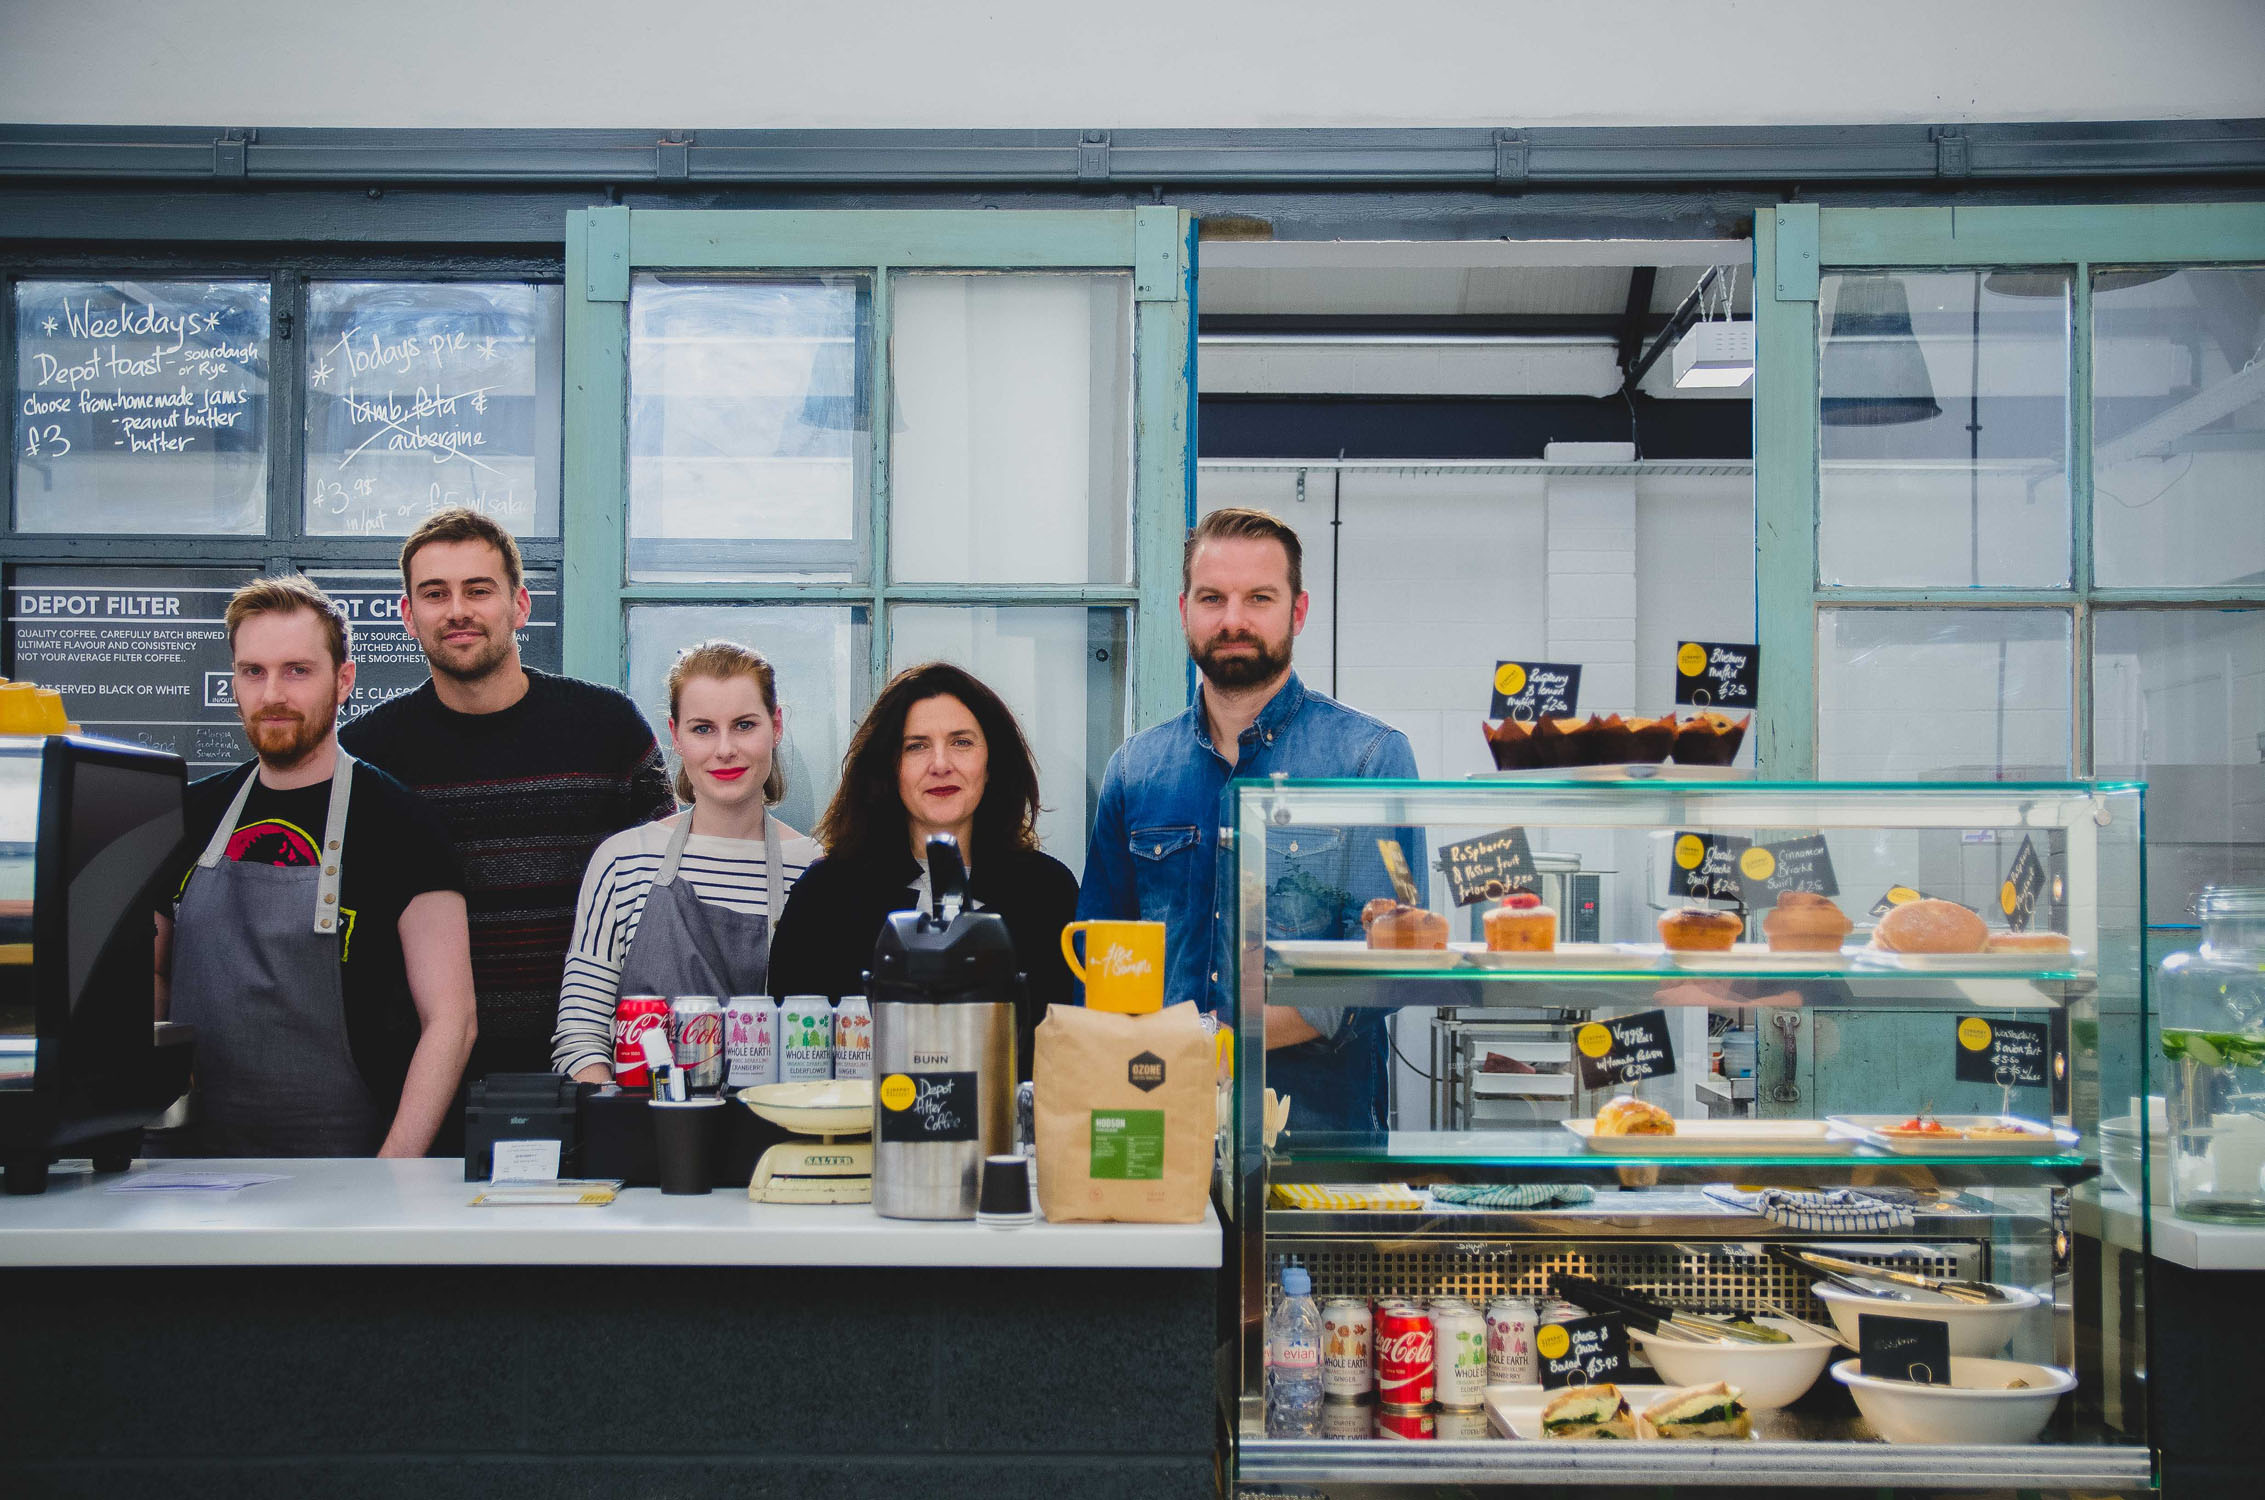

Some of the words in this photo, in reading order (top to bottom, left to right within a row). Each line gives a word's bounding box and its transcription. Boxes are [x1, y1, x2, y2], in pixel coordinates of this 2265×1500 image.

[63, 297, 201, 353] Weekdays
[429, 332, 470, 368] pie
[32, 347, 101, 391] Depot
[105, 344, 163, 379] toast
[179, 363, 195, 376] or
[185, 408, 242, 429] butter
[131, 432, 195, 453] butter
[20, 595, 100, 614] DEPOT
[107, 596, 180, 616] FILTER
[17, 629, 57, 639] QUALITY
[59, 629, 98, 640] COFFEE,
[100, 630, 151, 639] CAREFULLY
[153, 631, 184, 639] BATCH
[186, 631, 225, 640] BREWED
[17, 641, 61, 649] ULTIMATE
[64, 641, 106, 650] FLAVOUR
[108, 641, 129, 650] AND
[131, 642, 196, 651] CONSISTENCY
[395, 644, 417, 652] AND
[17, 653, 38, 661] NOT
[40, 653, 66, 661] YOUR
[67, 653, 111, 662] AVERAGE
[113, 653, 143, 662] FILTER
[55, 685, 96, 694] SERVED
[99, 685, 134, 695] BLACK
[136, 685, 153, 695] OR
[155, 685, 190, 695] WHITE
[727, 1047, 749, 1056] WHOLE
[749, 1047, 771, 1056] EARTH
[786, 1050, 811, 1059] WHOLE
[913, 1055, 948, 1064] BUNN
[1132, 1064, 1161, 1075] OZONE
[1283, 1348, 1315, 1359] evian
[1324, 1356, 1346, 1368] WHOLE
[1347, 1358, 1368, 1369] EARTH
[1507, 1355, 1529, 1366] EARTH
[1454, 1367, 1480, 1378] WHOLE
